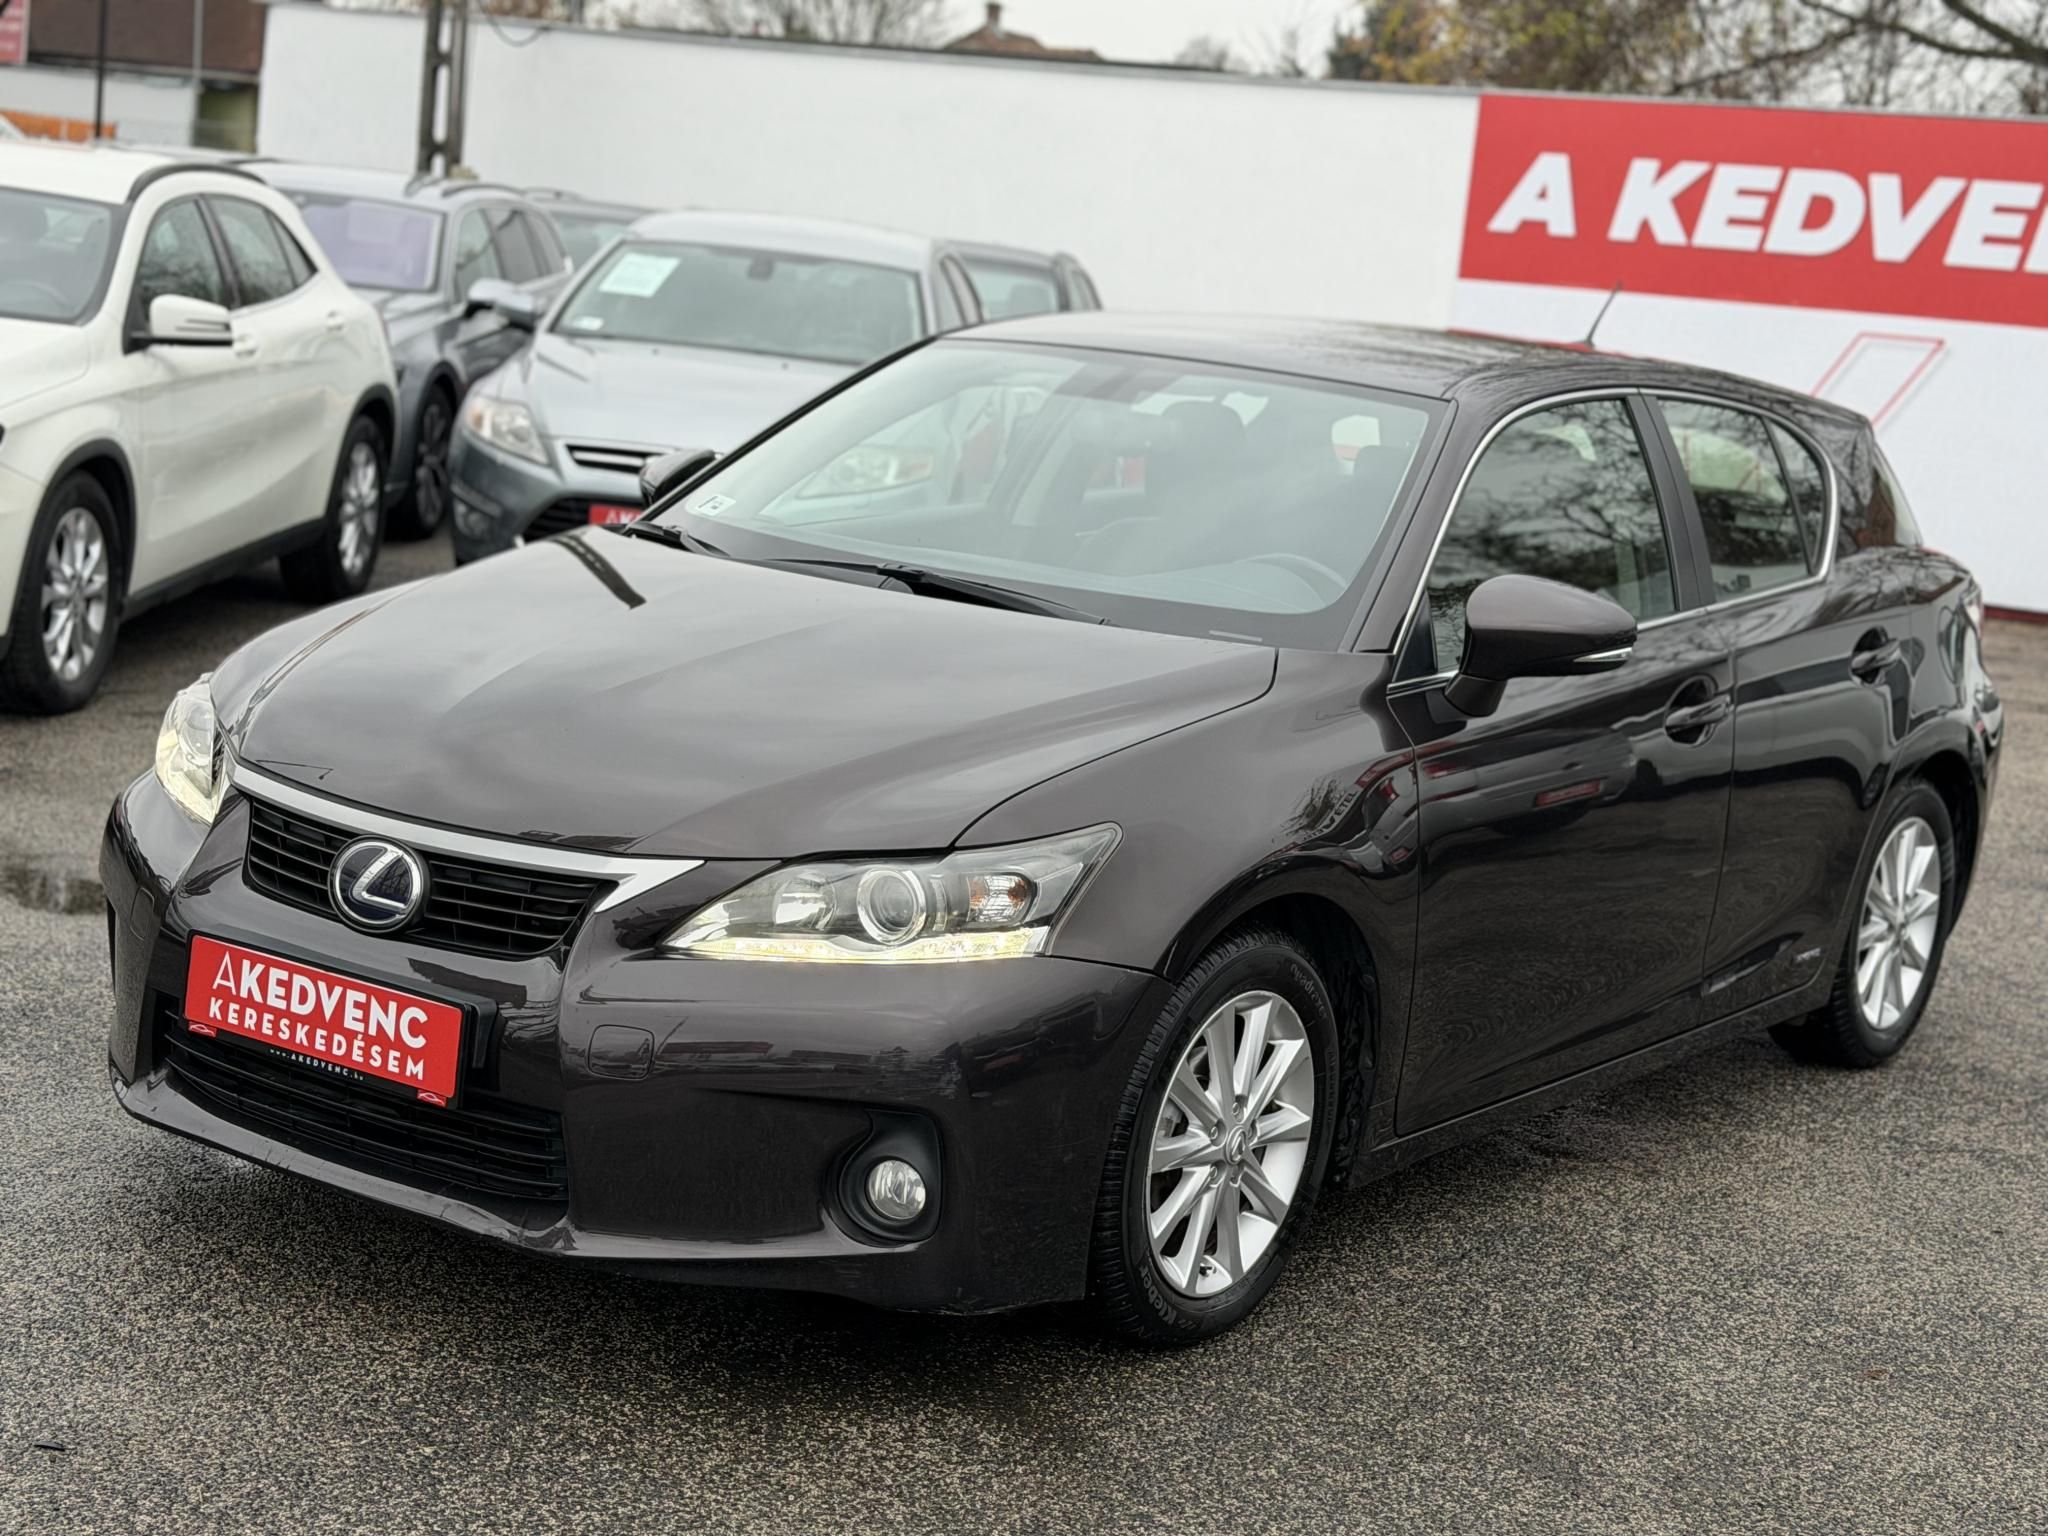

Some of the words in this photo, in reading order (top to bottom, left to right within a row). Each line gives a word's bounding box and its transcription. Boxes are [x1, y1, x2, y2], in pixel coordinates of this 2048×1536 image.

[1487, 151, 1576, 238] A
[1607, 157, 2048, 274] KEDVE
[209, 997, 424, 1080] KERESKEDÉSEM
